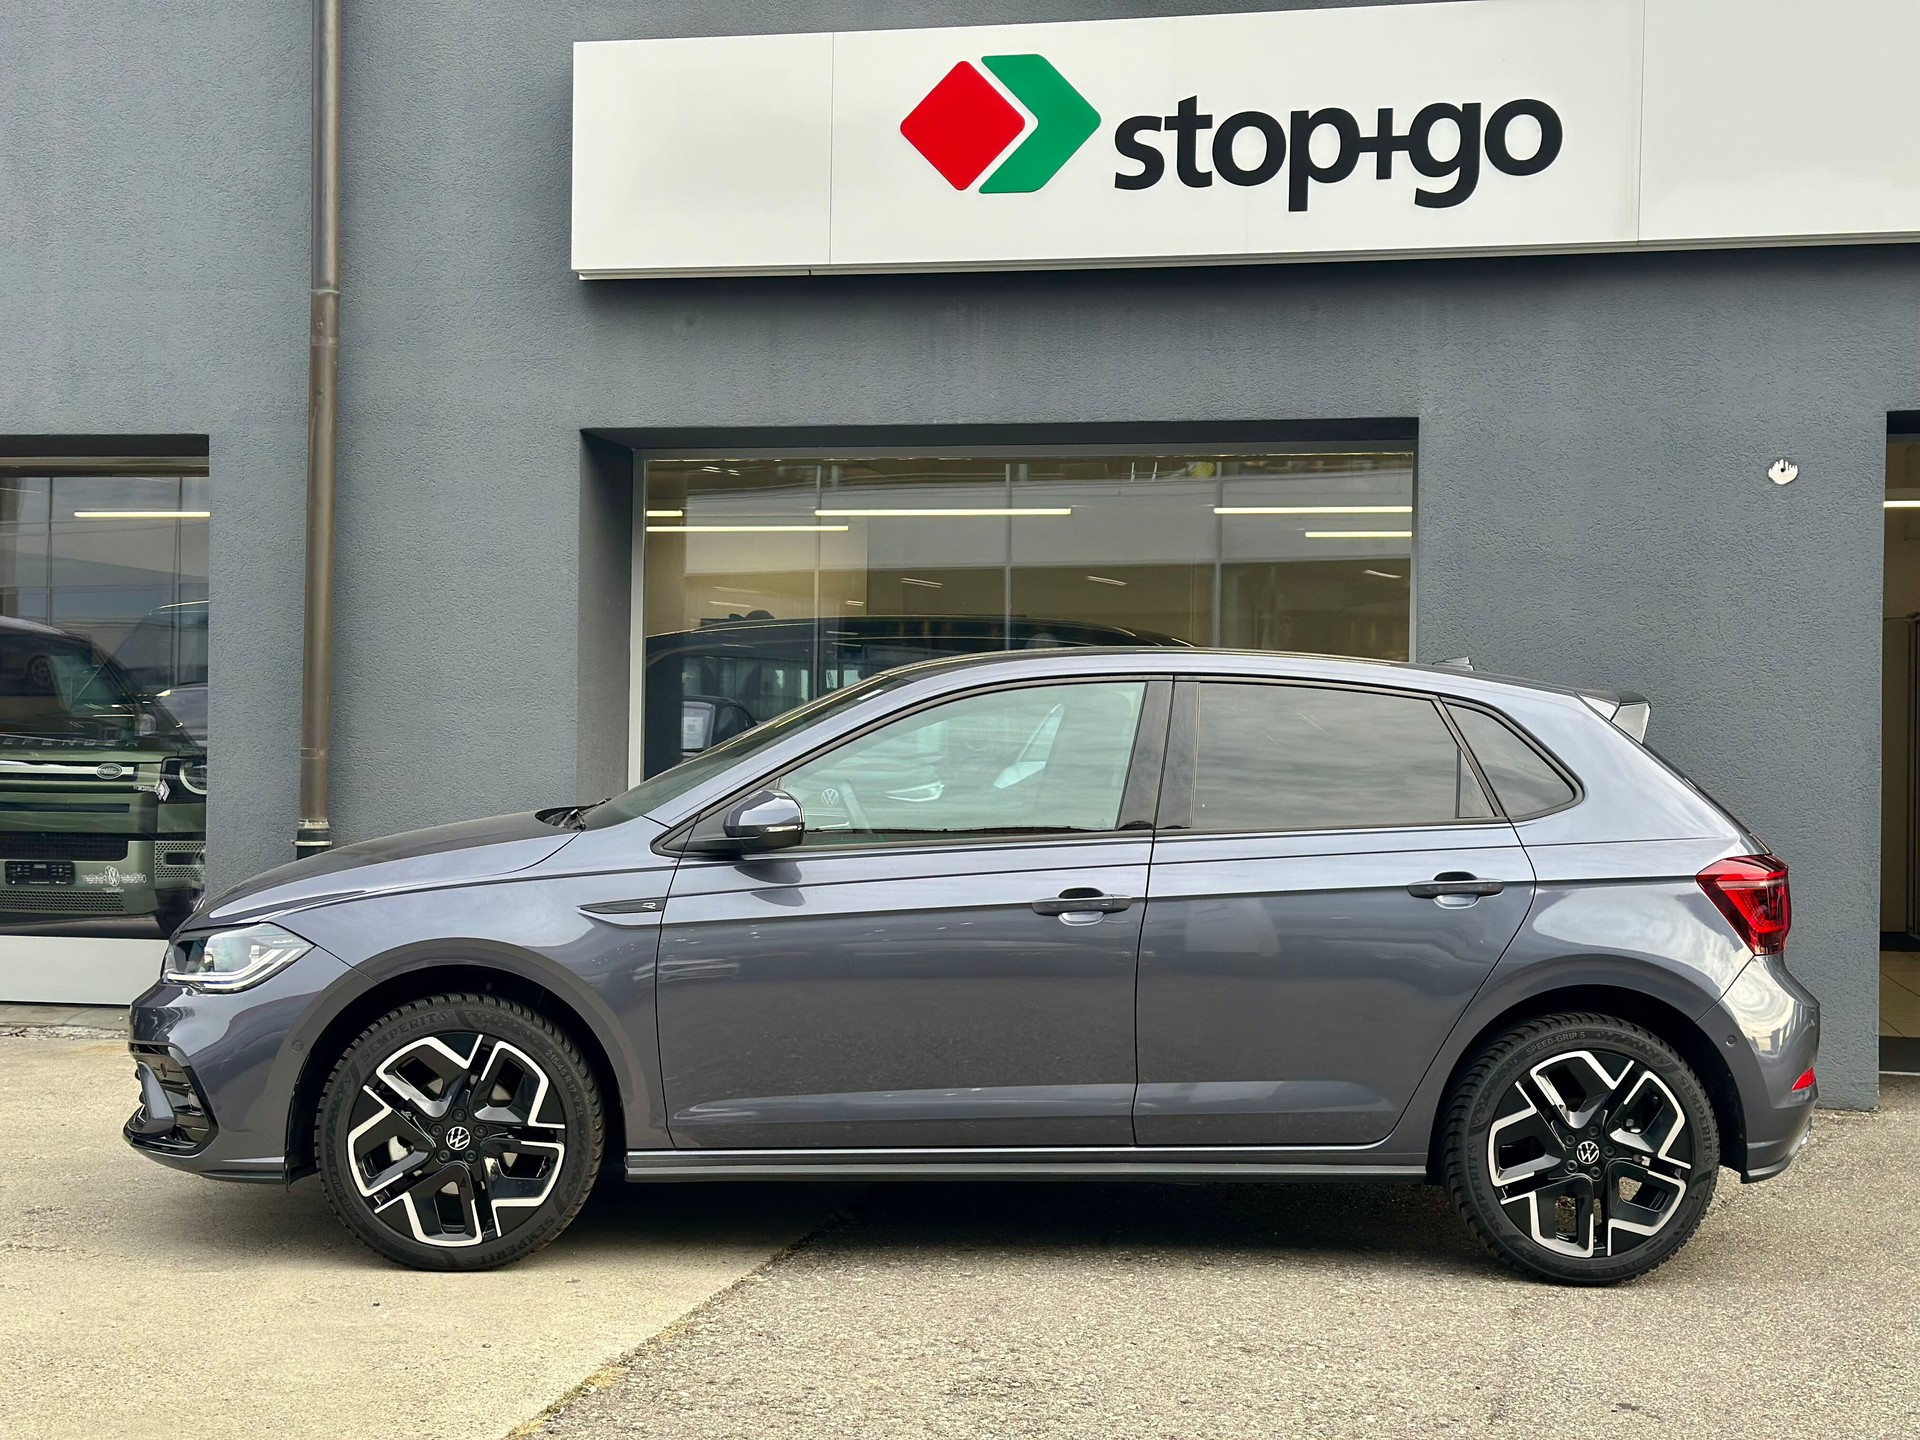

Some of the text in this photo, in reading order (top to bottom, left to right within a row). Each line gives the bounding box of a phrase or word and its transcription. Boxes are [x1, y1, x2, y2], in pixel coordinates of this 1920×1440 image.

[1113, 94, 1564, 213] stop+go
[361, 1013, 436, 1062] SEMPERIT
[1525, 1031, 1586, 1056] SPEED-GRIP 5
[564, 1075, 572, 1084] R
[568, 1084, 577, 1093] 17
[574, 1105, 584, 1118] XL
[1680, 1076, 1713, 1153] SEMPERIT
[446, 1126, 470, 1150] VW
[1576, 1141, 1600, 1164] VW
[480, 1216, 555, 1265] SEMPERIT
